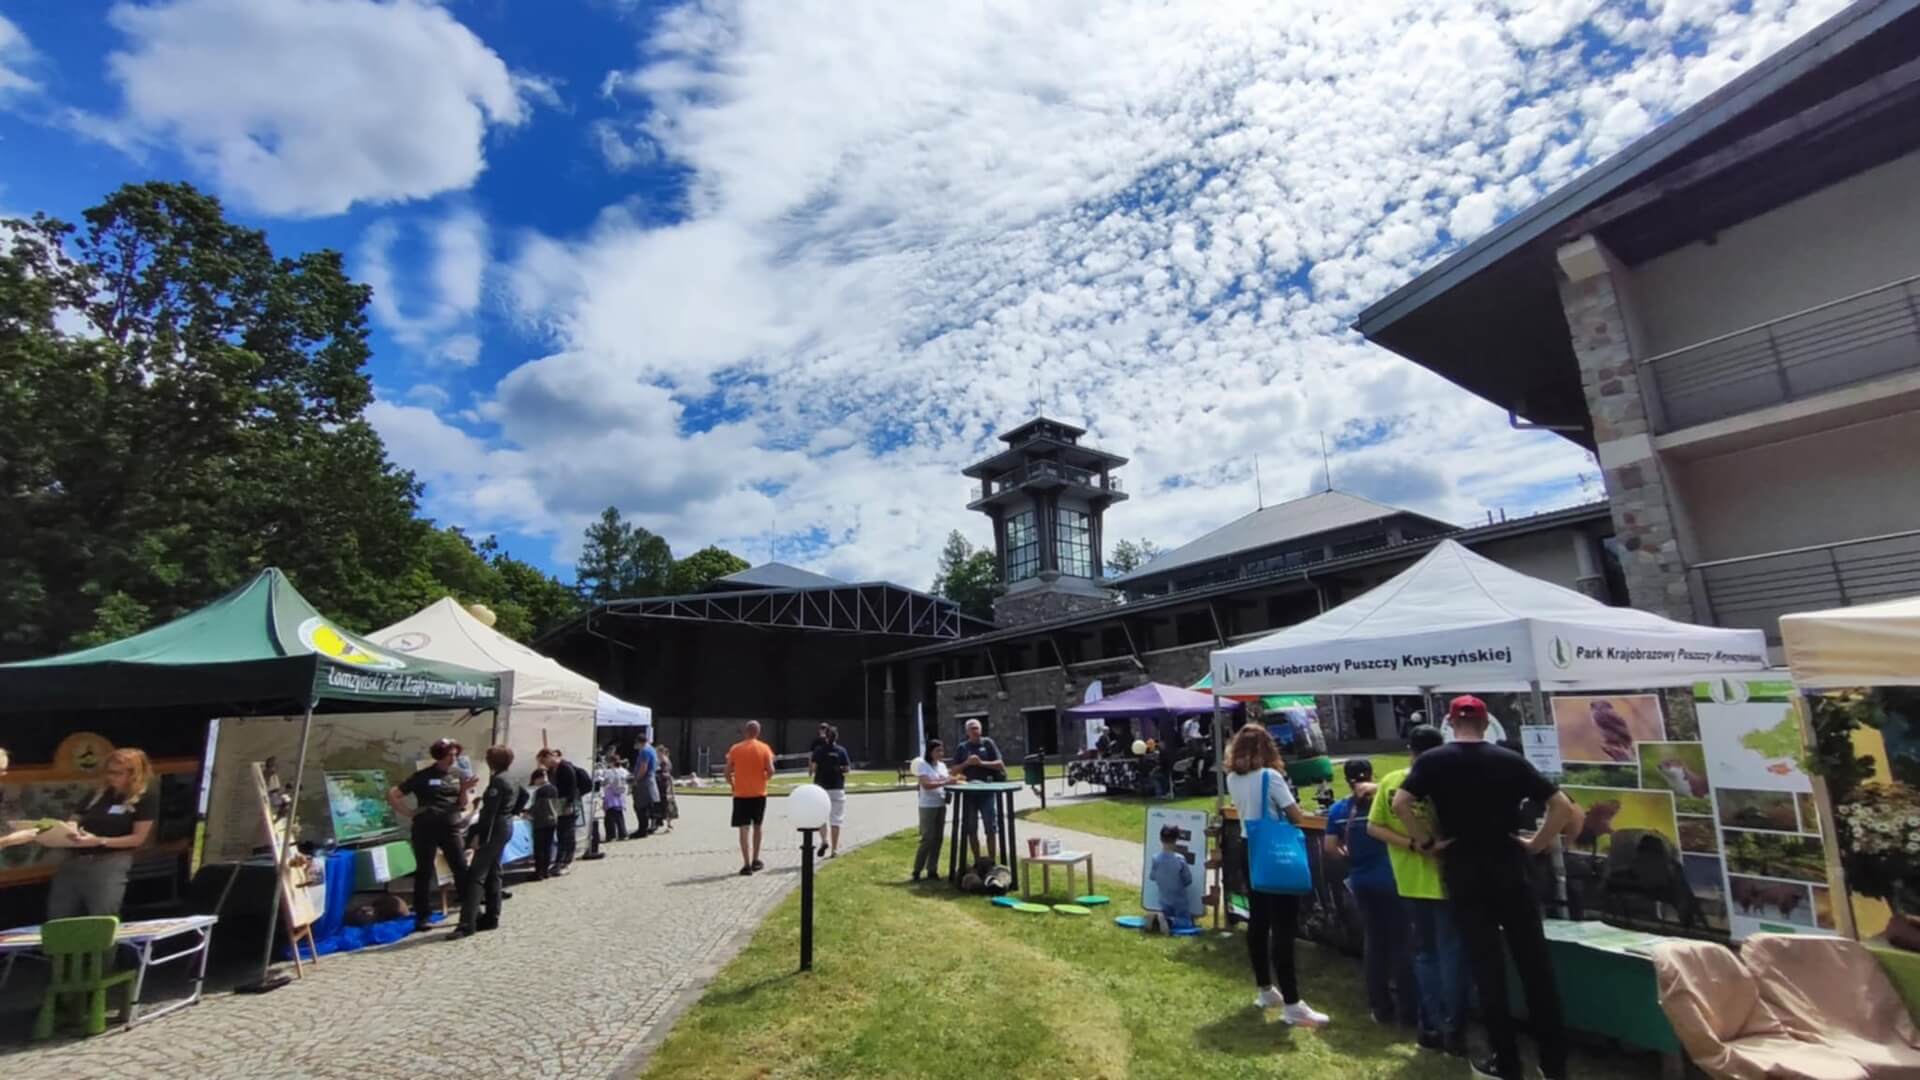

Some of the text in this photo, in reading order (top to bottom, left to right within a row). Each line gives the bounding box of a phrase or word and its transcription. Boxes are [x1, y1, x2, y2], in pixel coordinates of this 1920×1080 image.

[1238, 646, 1512, 679] Park Krajobrazowy Puszczy Knyszyńskiej
[1576, 646, 1603, 660] Park
[1607, 646, 1675, 664] Krajobrazowy
